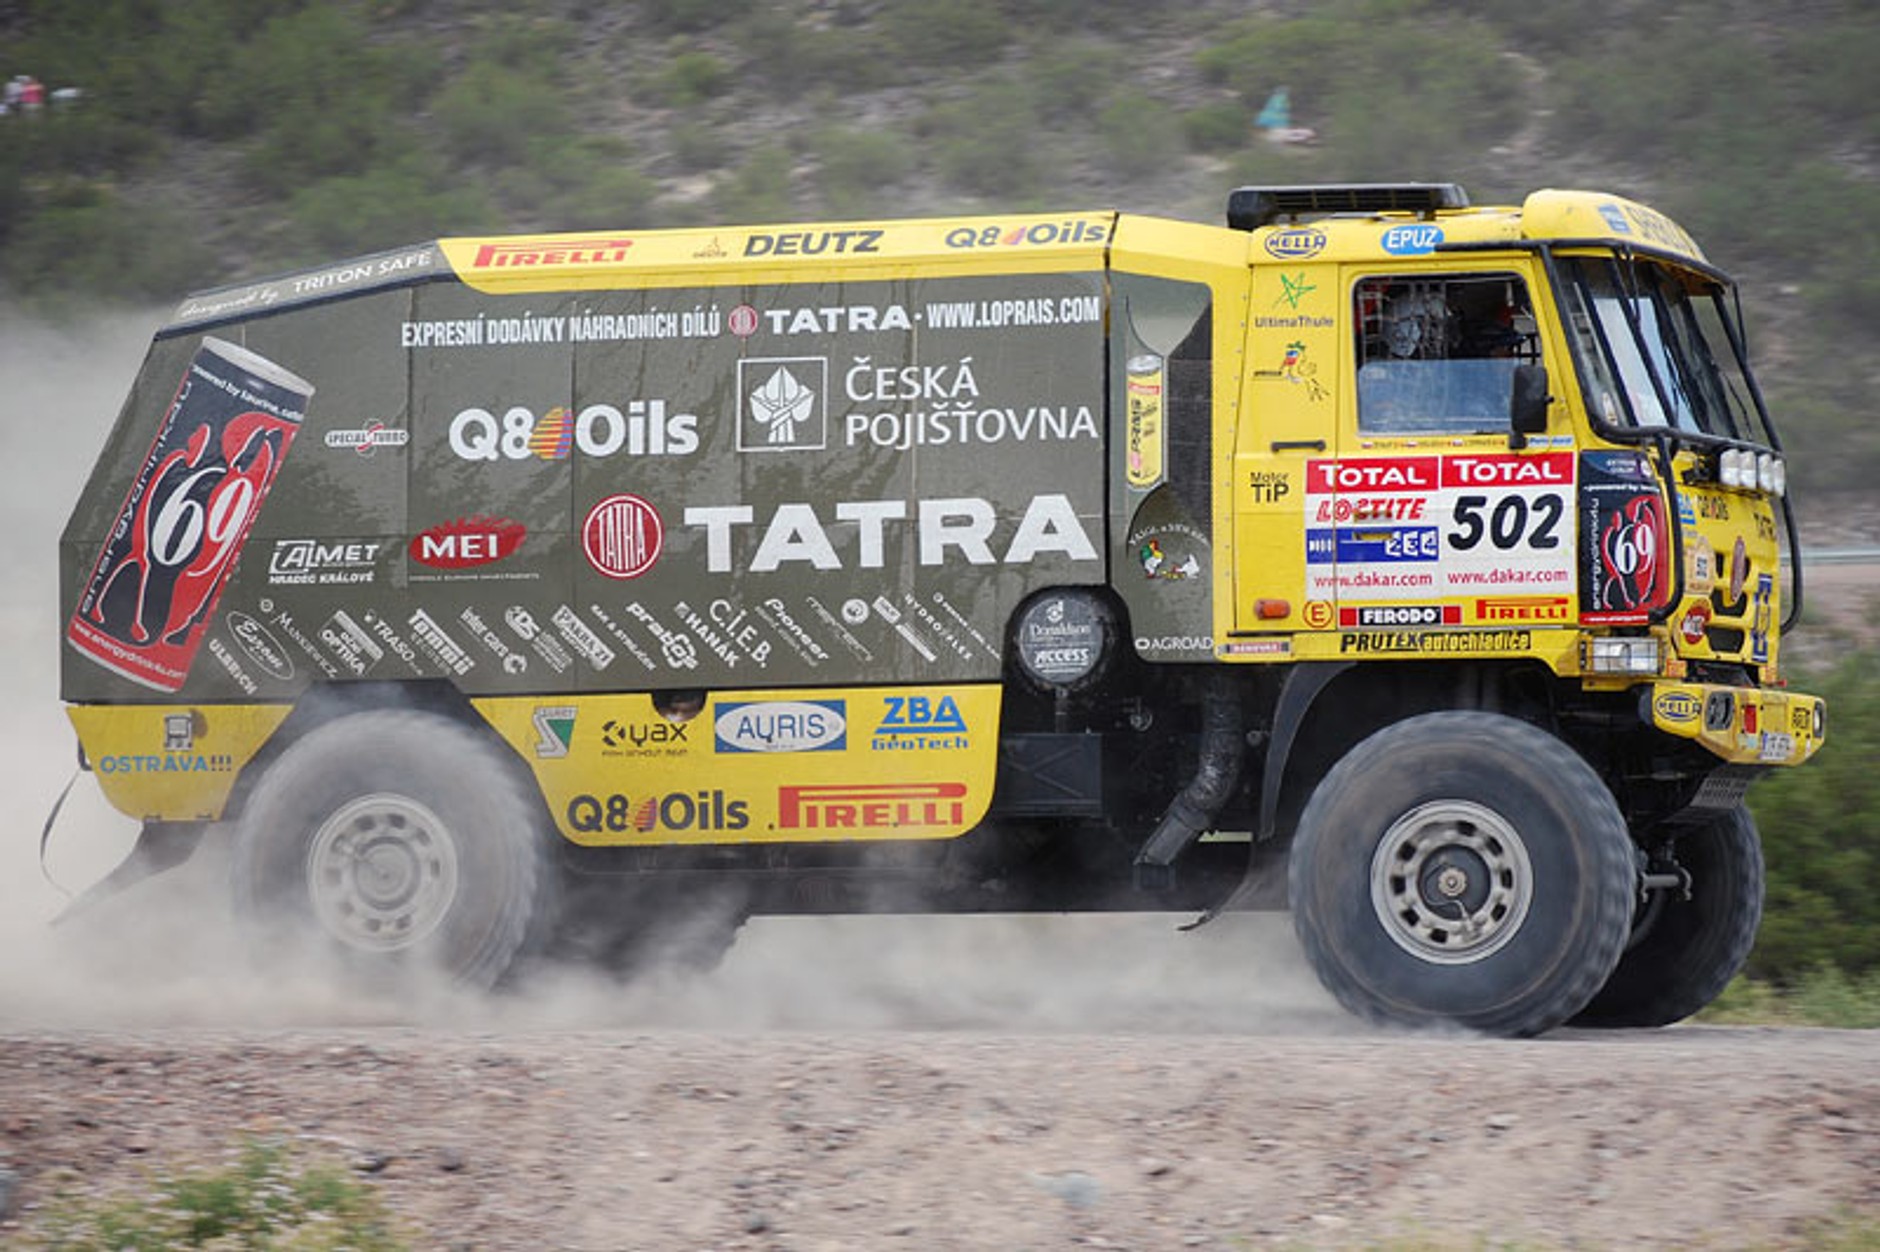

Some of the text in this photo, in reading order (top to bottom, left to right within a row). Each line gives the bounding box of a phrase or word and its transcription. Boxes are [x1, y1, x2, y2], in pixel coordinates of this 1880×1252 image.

[743, 228, 885, 257] DEUTZ
[944, 220, 1107, 249] Q8 Oils
[1387, 228, 1438, 249] EPUZ
[473, 240, 634, 268] PIRELLI
[292, 266, 374, 294] TRITON
[378, 251, 433, 276] SAFE
[401, 312, 486, 347] EXPRESNÍ
[486, 310, 566, 345] DODÁVKY
[569, 306, 678, 342] NÁHRADNÍCH
[682, 304, 721, 338] DÍLŮ
[765, 304, 913, 335] TATRA
[926, 296, 1100, 329] WWW.LOPRAIS.COM
[846, 356, 980, 401] ČESKÁ
[448, 400, 700, 462] Q8 Oils
[846, 400, 1099, 450] POJIŠŤOVNA
[1318, 463, 1427, 487] TOTAL
[1453, 459, 1563, 483] TOTAL
[152, 466, 253, 578] 69
[597, 502, 647, 571] TATRA
[683, 494, 1099, 573] TATRA
[1448, 493, 1565, 552] 502
[421, 533, 499, 560] MEI
[1614, 523, 1655, 575] 69
[1314, 571, 1433, 588] www.dakar.com
[1448, 568, 1569, 585] www.dakar.com
[1362, 609, 1438, 625] FERODO
[1476, 596, 1569, 620] PIRELLI
[763, 597, 830, 662] Pioneer
[1340, 632, 1422, 654] PRUTEX
[1034, 647, 1090, 664] ACCESS
[880, 695, 967, 730] ZBA
[871, 736, 970, 751] GeoTech
[100, 755, 233, 774] OSTRAVA!!!
[566, 789, 749, 833] Q8 Oils
[778, 782, 968, 829] PIRELLI
